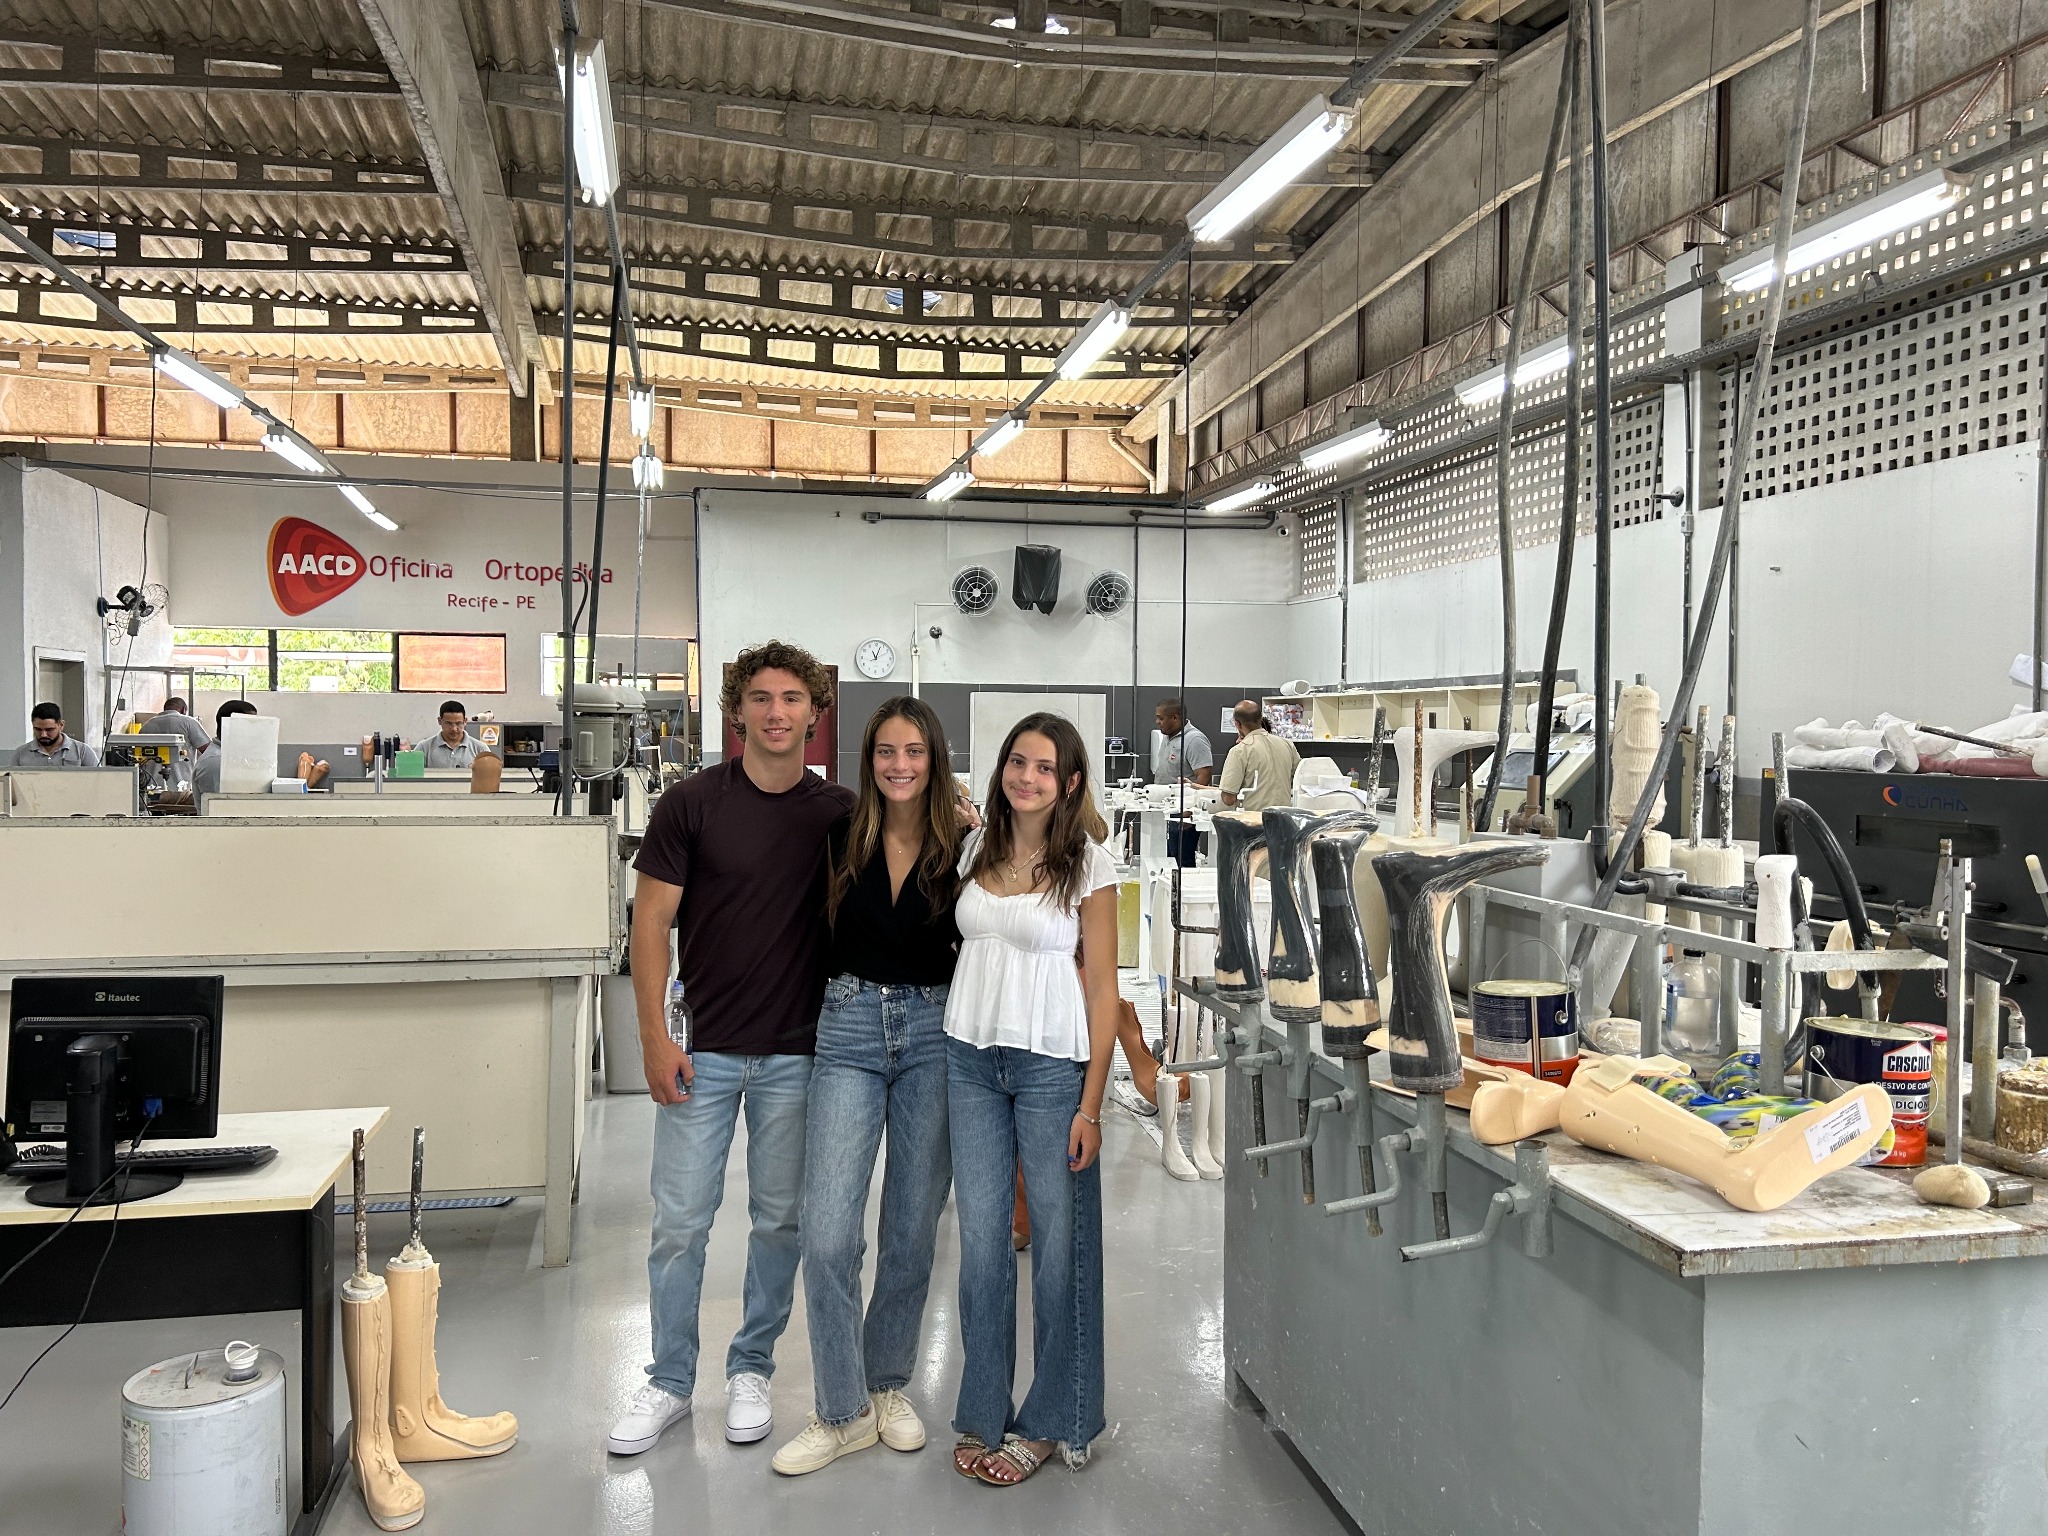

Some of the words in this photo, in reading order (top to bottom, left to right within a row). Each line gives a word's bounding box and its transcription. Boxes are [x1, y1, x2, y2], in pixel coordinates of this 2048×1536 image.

[278, 553, 357, 576] AACD
[370, 556, 452, 582] Oficina
[448, 594, 498, 612] Recife
[517, 596, 536, 610] PE
[1905, 796, 1968, 812] CUNHA
[108, 994, 140, 1002] Itautec
